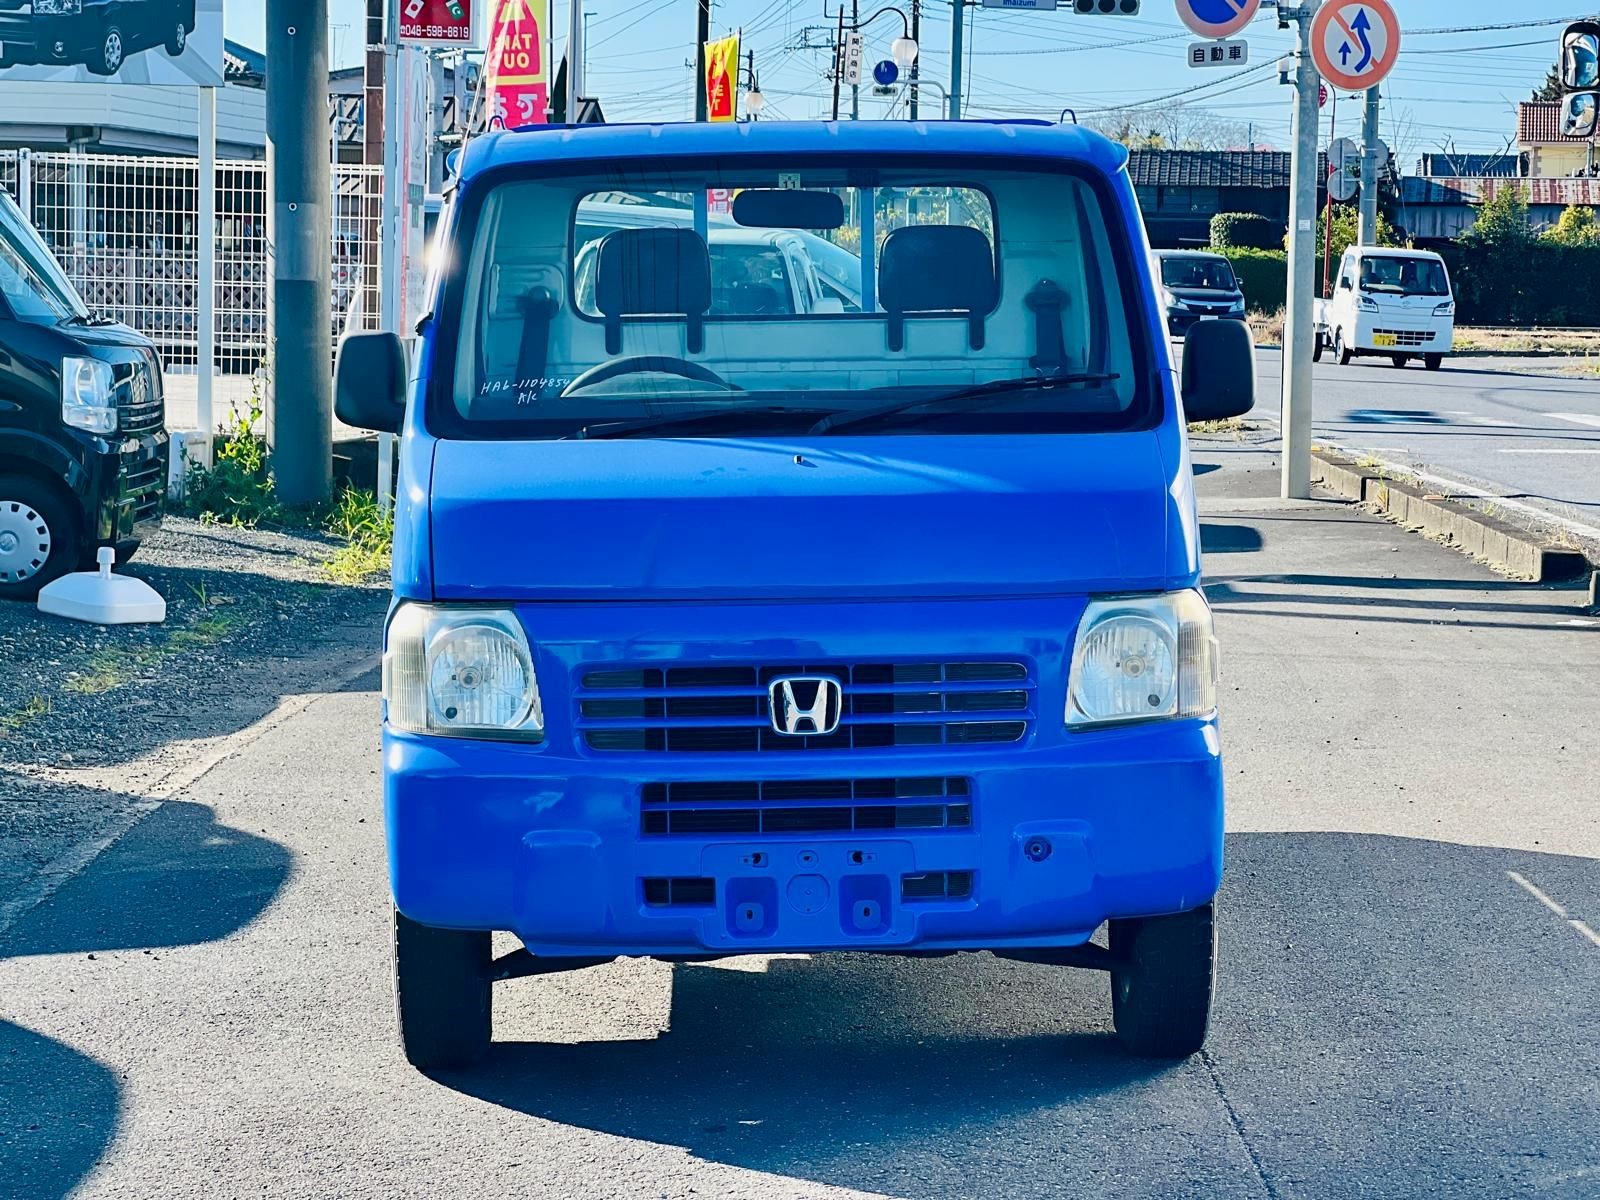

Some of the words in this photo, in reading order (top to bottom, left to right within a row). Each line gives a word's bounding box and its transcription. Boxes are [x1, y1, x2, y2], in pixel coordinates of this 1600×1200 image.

[405, 24, 469, 38] 048-598-8619
[1193, 45, 1242, 63] 自動車
